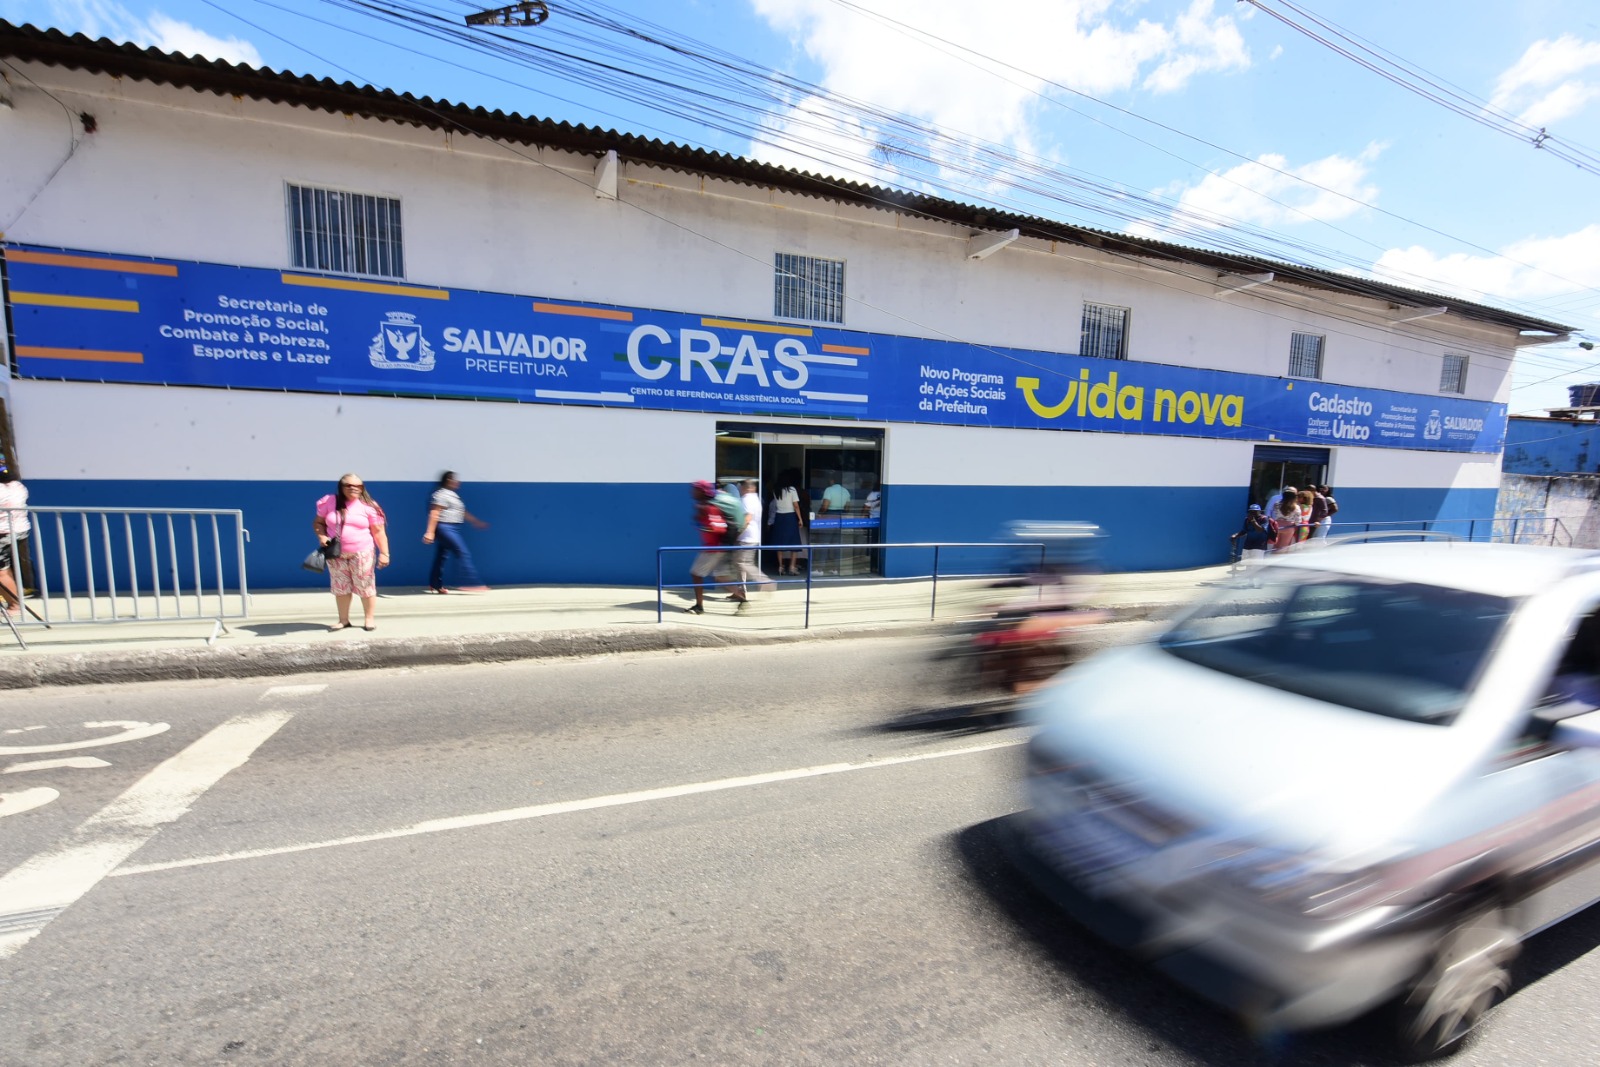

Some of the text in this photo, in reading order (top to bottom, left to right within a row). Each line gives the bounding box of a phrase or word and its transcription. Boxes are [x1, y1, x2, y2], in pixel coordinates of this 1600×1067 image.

[218, 295, 328, 316] Secretaria de
[183, 309, 329, 334] Promoção Social,
[159, 325, 330, 350] Combate à Pobreza,
[442, 327, 588, 362] SALVADOR
[193, 344, 331, 365] Esportes e Lazer
[626, 324, 809, 390] CRAS
[465, 357, 568, 378] PREFEITURA
[920, 365, 1004, 385] Novo Programa
[630, 387, 805, 405] CENTRO DE REFERÊNCIA DE ASSISTÊNCIA SOCIAL
[919, 381, 1006, 400] de Ações Sociais
[919, 398, 987, 415] da Prefeitura
[1153, 387, 1244, 427] nova
[1308, 391, 1372, 416] Cadastro
[1332, 414, 1370, 440] Único
[1443, 416, 1483, 432] SALVADOR
[1447, 431, 1476, 440] PREFEITURA
